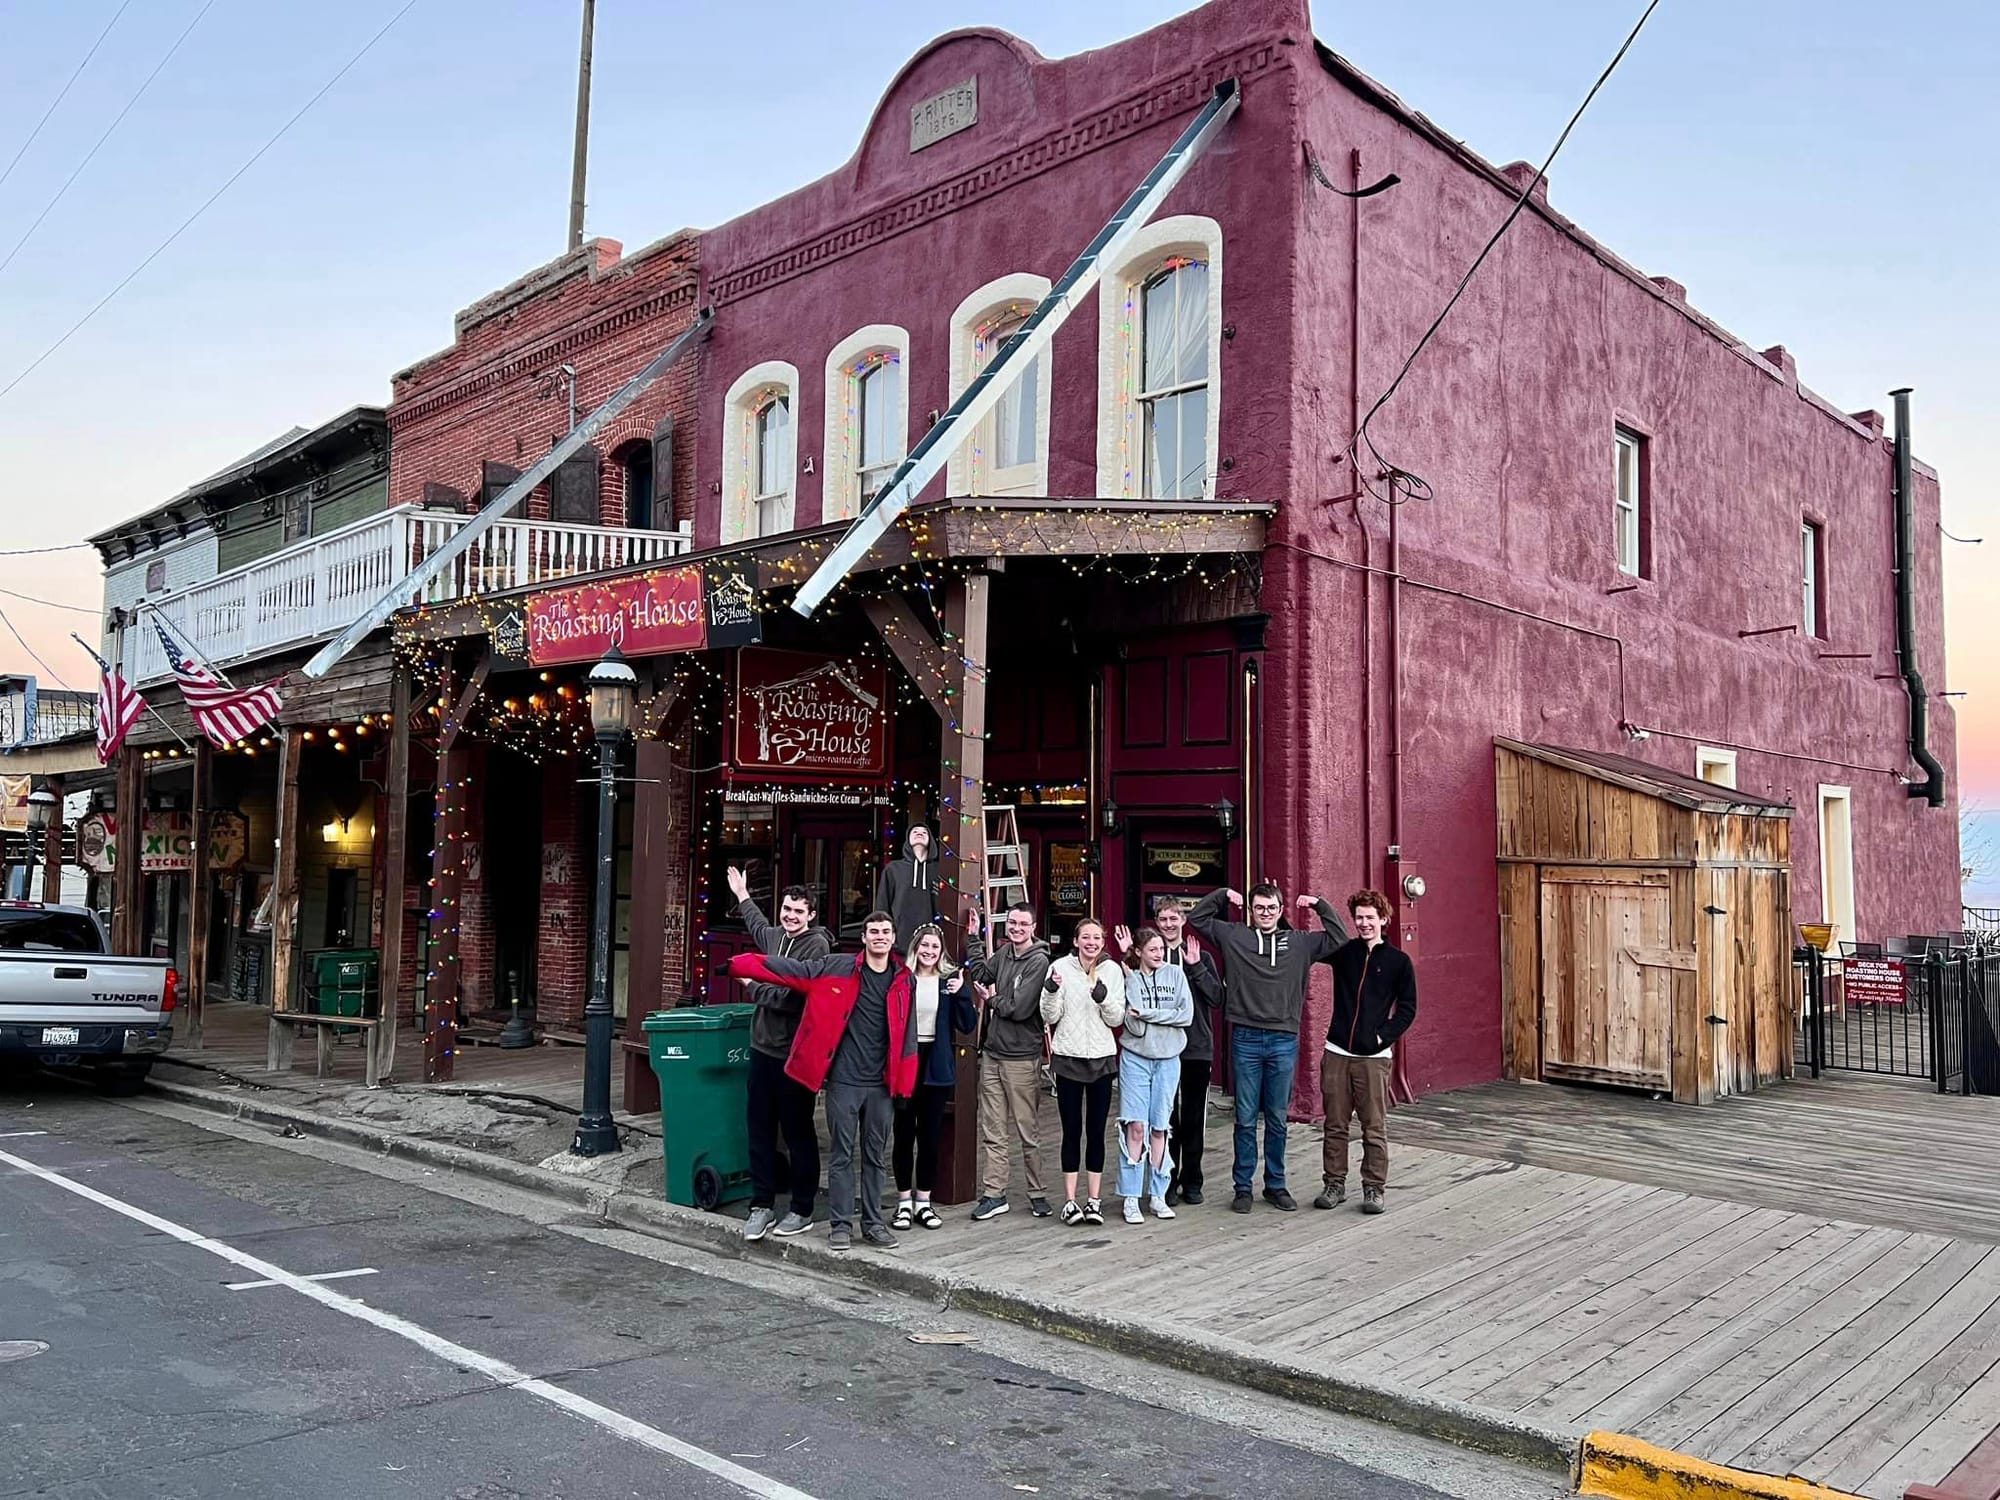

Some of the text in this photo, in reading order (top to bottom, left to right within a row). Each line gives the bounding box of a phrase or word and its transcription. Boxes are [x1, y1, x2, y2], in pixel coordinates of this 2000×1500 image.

[925, 90, 972, 122] RITTER
[534, 608, 624, 647] Roasting
[630, 589, 699, 629] House
[549, 601, 569, 620] The
[797, 685, 820, 701] The
[771, 691, 870, 736] Roasting
[807, 721, 871, 754] House
[805, 754, 872, 769] micro-roasted coffee
[841, 794, 860, 804] Cream
[874, 796, 889, 805] more
[1058, 891, 1082, 901] CLOSED
[91, 992, 159, 1003] TUNDRA
